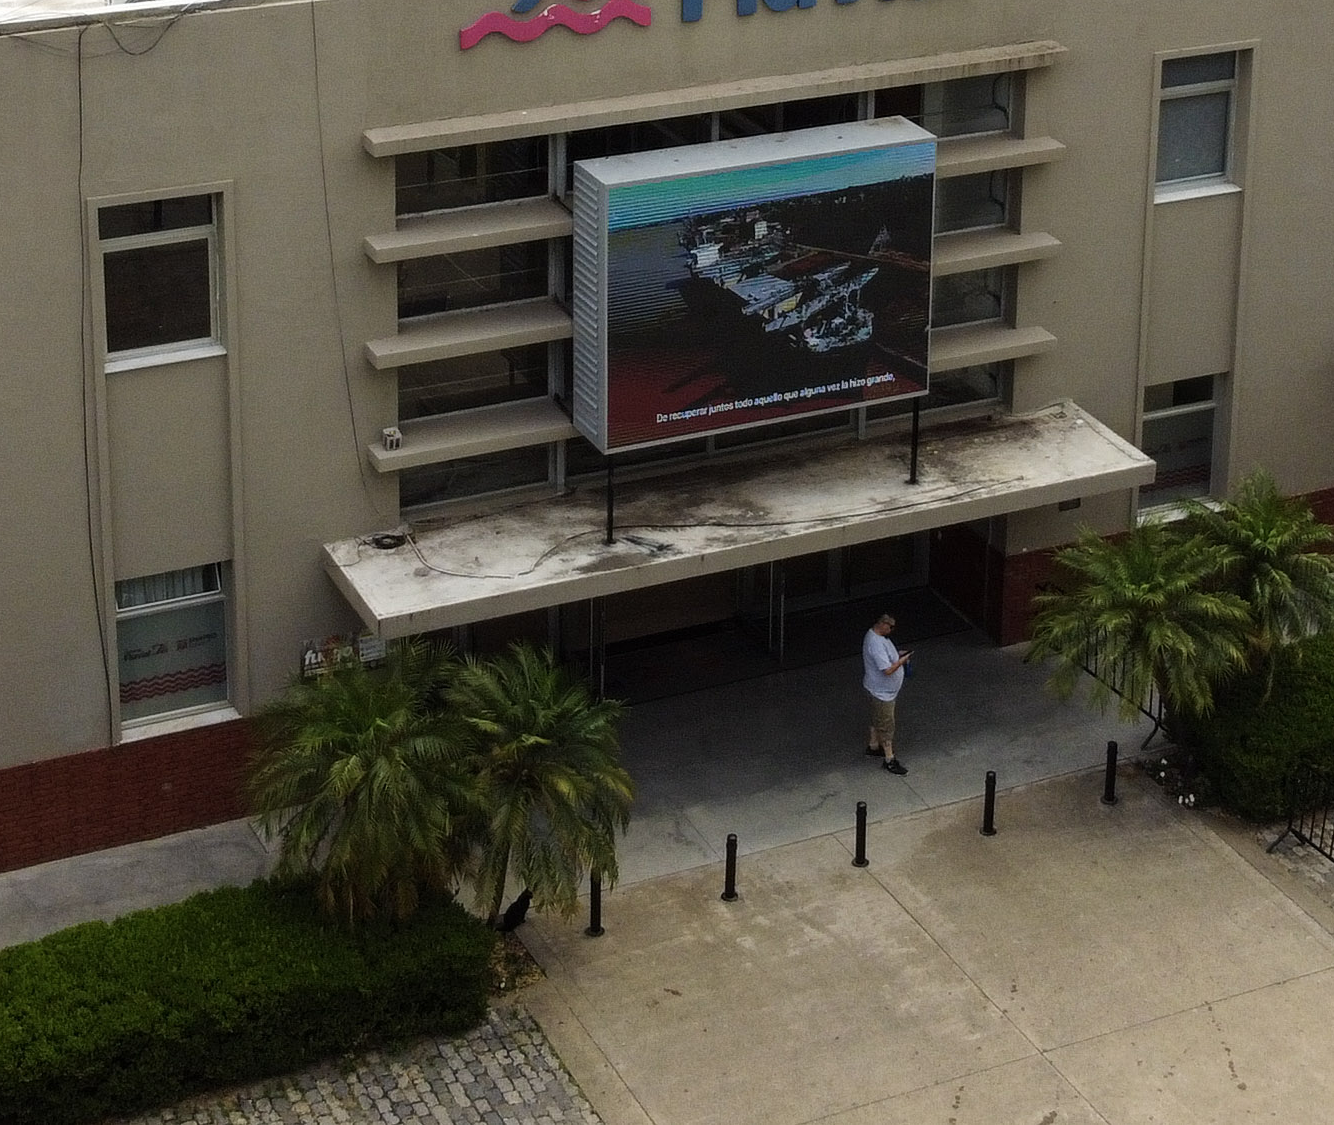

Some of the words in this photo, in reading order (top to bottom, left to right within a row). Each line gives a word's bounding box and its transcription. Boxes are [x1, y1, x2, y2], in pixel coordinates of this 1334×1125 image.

[656, 413, 668, 423] De
[669, 407, 708, 421] recuperar
[708, 402, 734, 416] juntos
[734, 398, 753, 409] todo
[754, 392, 782, 406] aquello
[784, 390, 799, 401] que
[799, 385, 825, 398] alguna
[827, 383, 840, 392] vez
[841, 380, 848, 389] la
[849, 378, 865, 388] hizo
